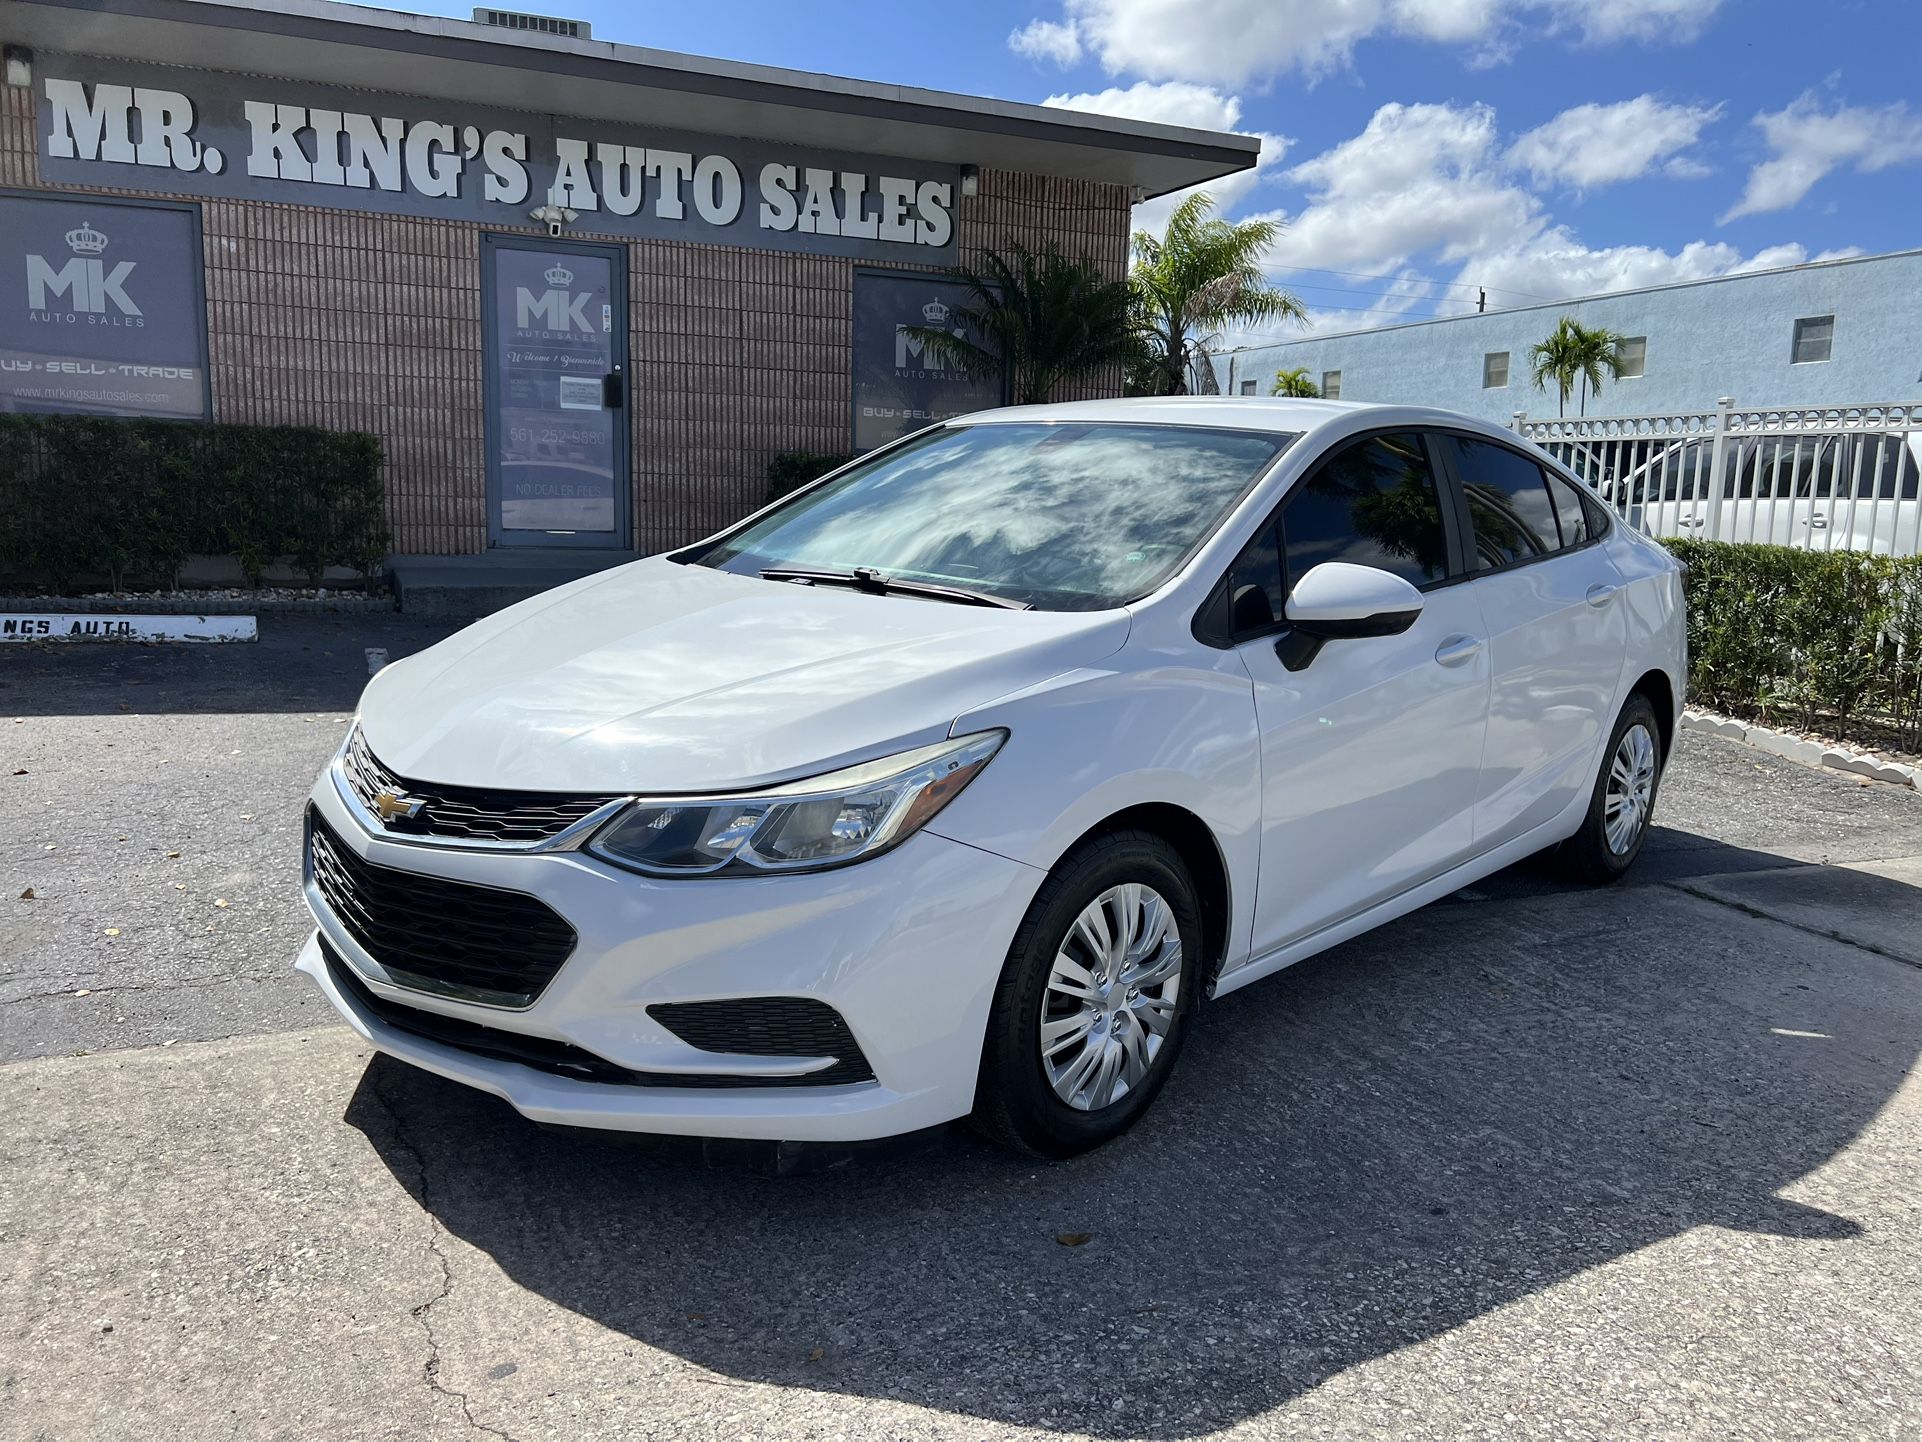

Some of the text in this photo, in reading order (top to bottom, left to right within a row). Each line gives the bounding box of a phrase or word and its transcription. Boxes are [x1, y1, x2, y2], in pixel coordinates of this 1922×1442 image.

[45, 77, 953, 248] MR. KING'S AUTO SALES
[26, 254, 144, 316] MK
[516, 286, 596, 333] MK
[29, 311, 145, 328] AUTO SALES
[516, 330, 597, 342] AUTO SALES
[506, 351, 550, 363] Welcome
[46, 361, 105, 375] SELL
[118, 364, 194, 379] TRADE
[894, 369, 969, 382] AUTO SALES
[13, 386, 170, 404] www.mrkingsautosales.com
[863, 407, 896, 418] BUY
[902, 409, 941, 420] SELL
[515, 483, 602, 497] NO DEALER FEES
[70, 620, 131, 635] AUTO
